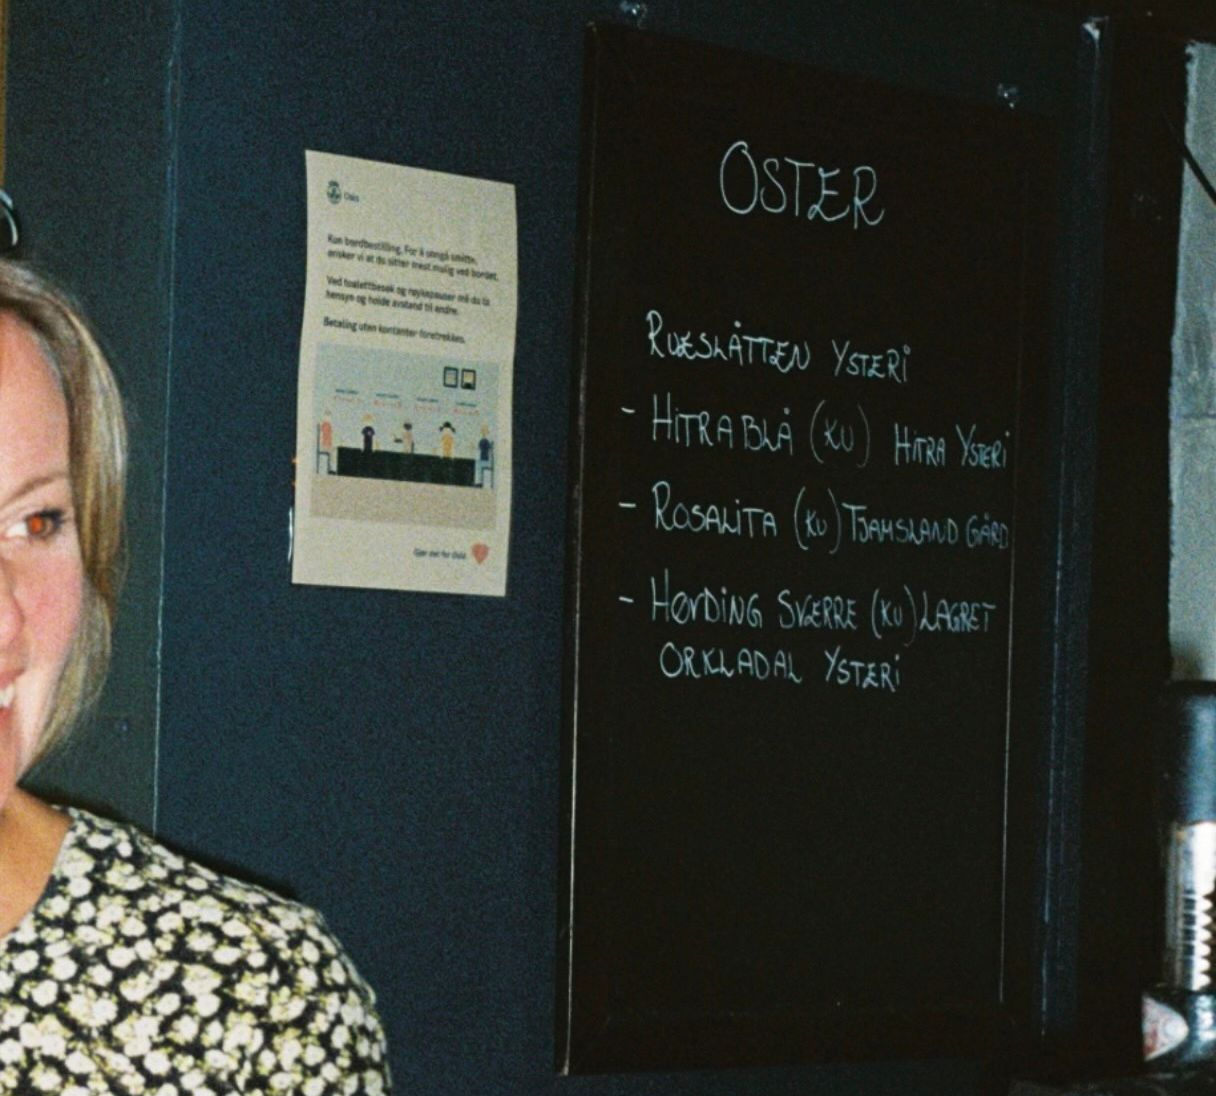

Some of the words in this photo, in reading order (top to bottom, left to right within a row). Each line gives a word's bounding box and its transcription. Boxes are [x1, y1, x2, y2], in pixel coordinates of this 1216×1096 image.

[719, 140, 885, 230] OSTER
[326, 275, 343, 286] Ved
[323, 316, 358, 332] Betaling
[359, 322, 377, 332] uten
